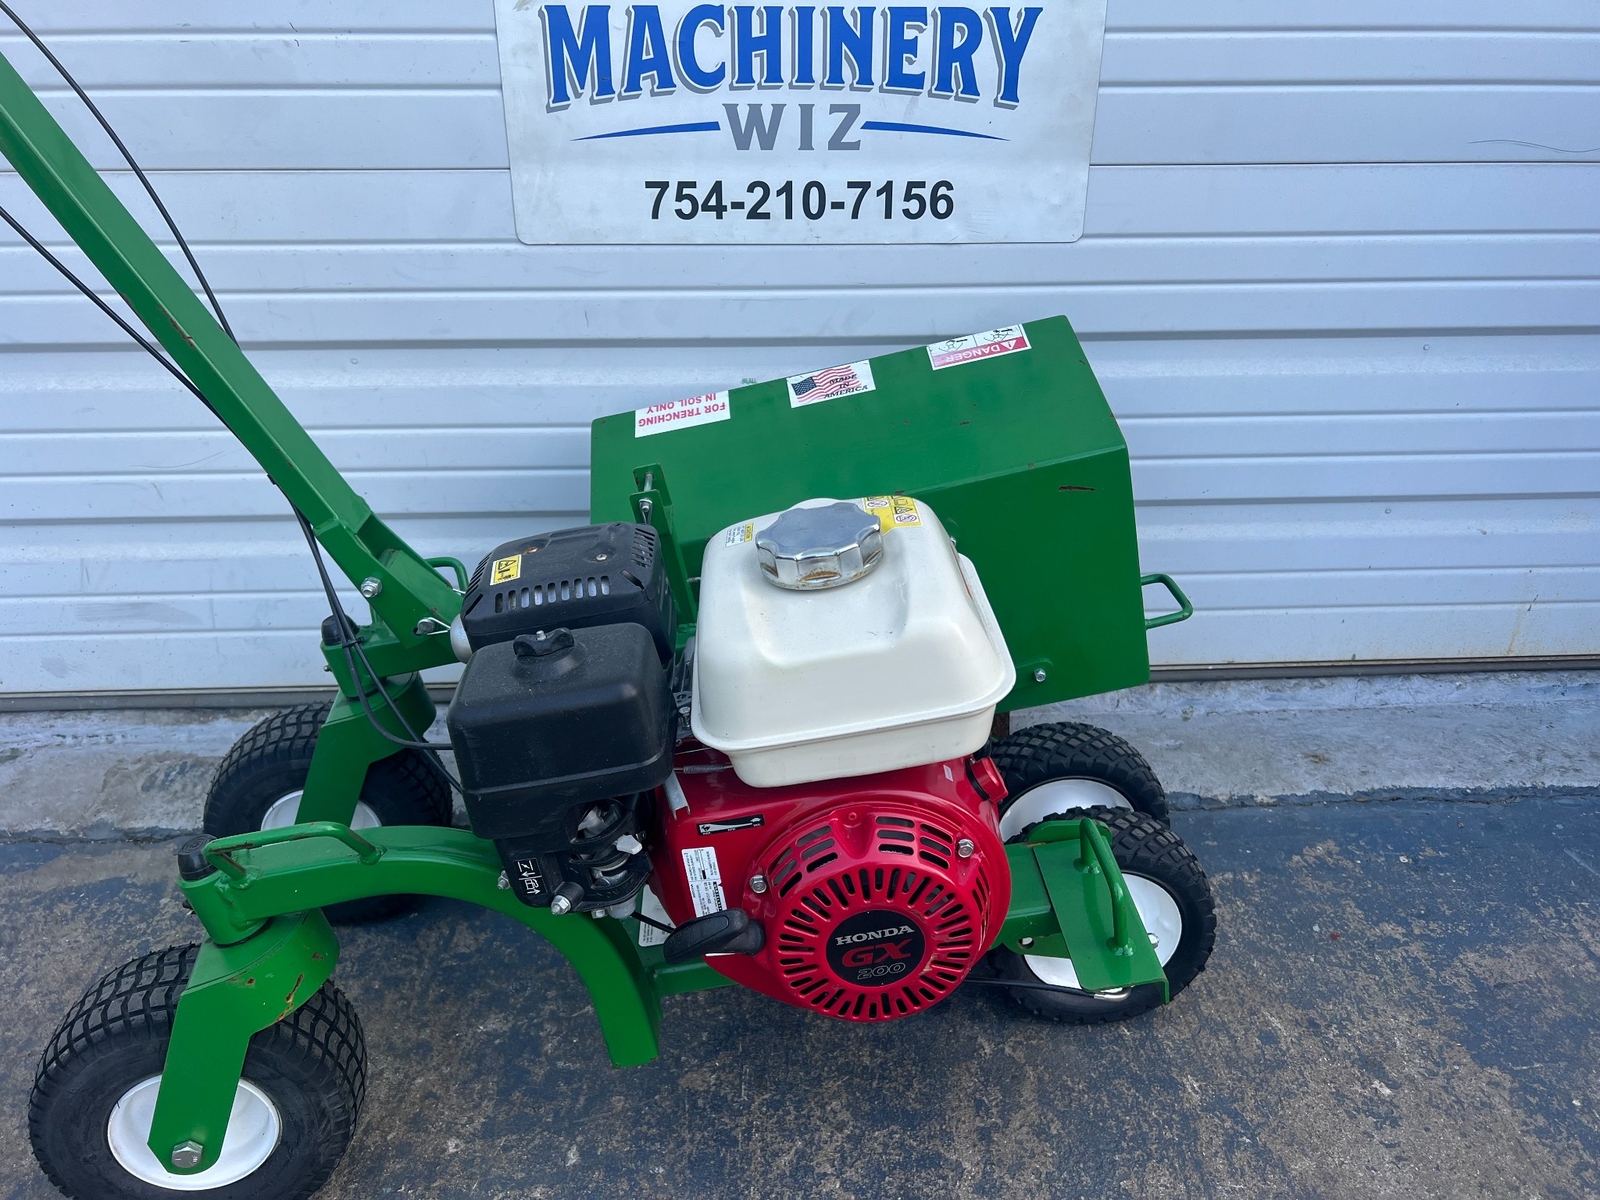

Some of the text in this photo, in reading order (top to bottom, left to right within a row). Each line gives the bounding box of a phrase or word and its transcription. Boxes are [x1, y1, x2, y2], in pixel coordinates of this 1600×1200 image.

[538, 3, 1044, 112] MACHINERY
[722, 103, 862, 151] WIZ
[644, 180, 955, 221] 754-210-7156
[944, 344, 1001, 362] DANGER
[829, 373, 857, 385] MADE
[823, 384, 868, 399] AMERICA
[646, 393, 717, 414] IN SOIL ONLY
[638, 402, 726, 427] FOR TRENCHING
[835, 925, 915, 946] HONDA
[841, 939, 913, 967] GX
[857, 962, 906, 980] 200
